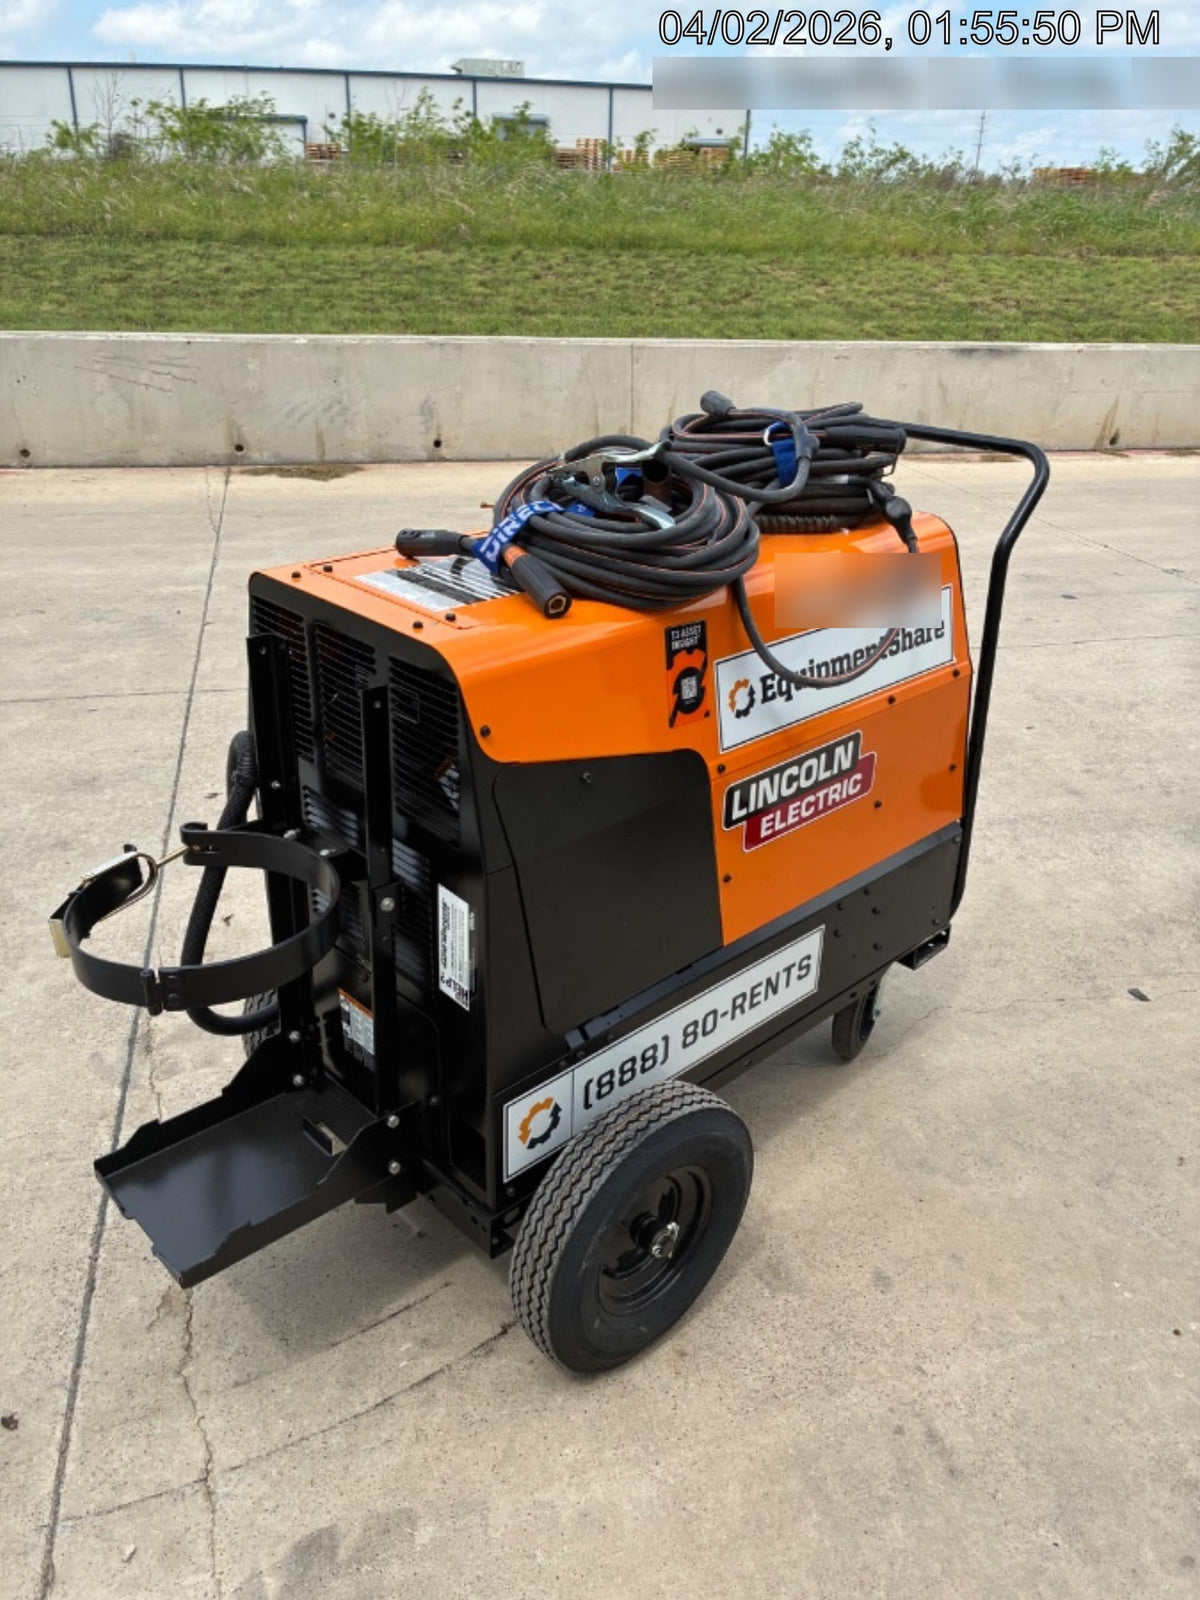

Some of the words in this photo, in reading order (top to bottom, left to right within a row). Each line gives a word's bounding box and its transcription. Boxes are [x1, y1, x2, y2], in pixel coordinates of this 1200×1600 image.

[731, 740, 855, 821] LINCOLN
[759, 773, 863, 839] ELECTRIC
[583, 1035, 671, 1111] (888)
[681, 953, 812, 1050] 80-RENTS
